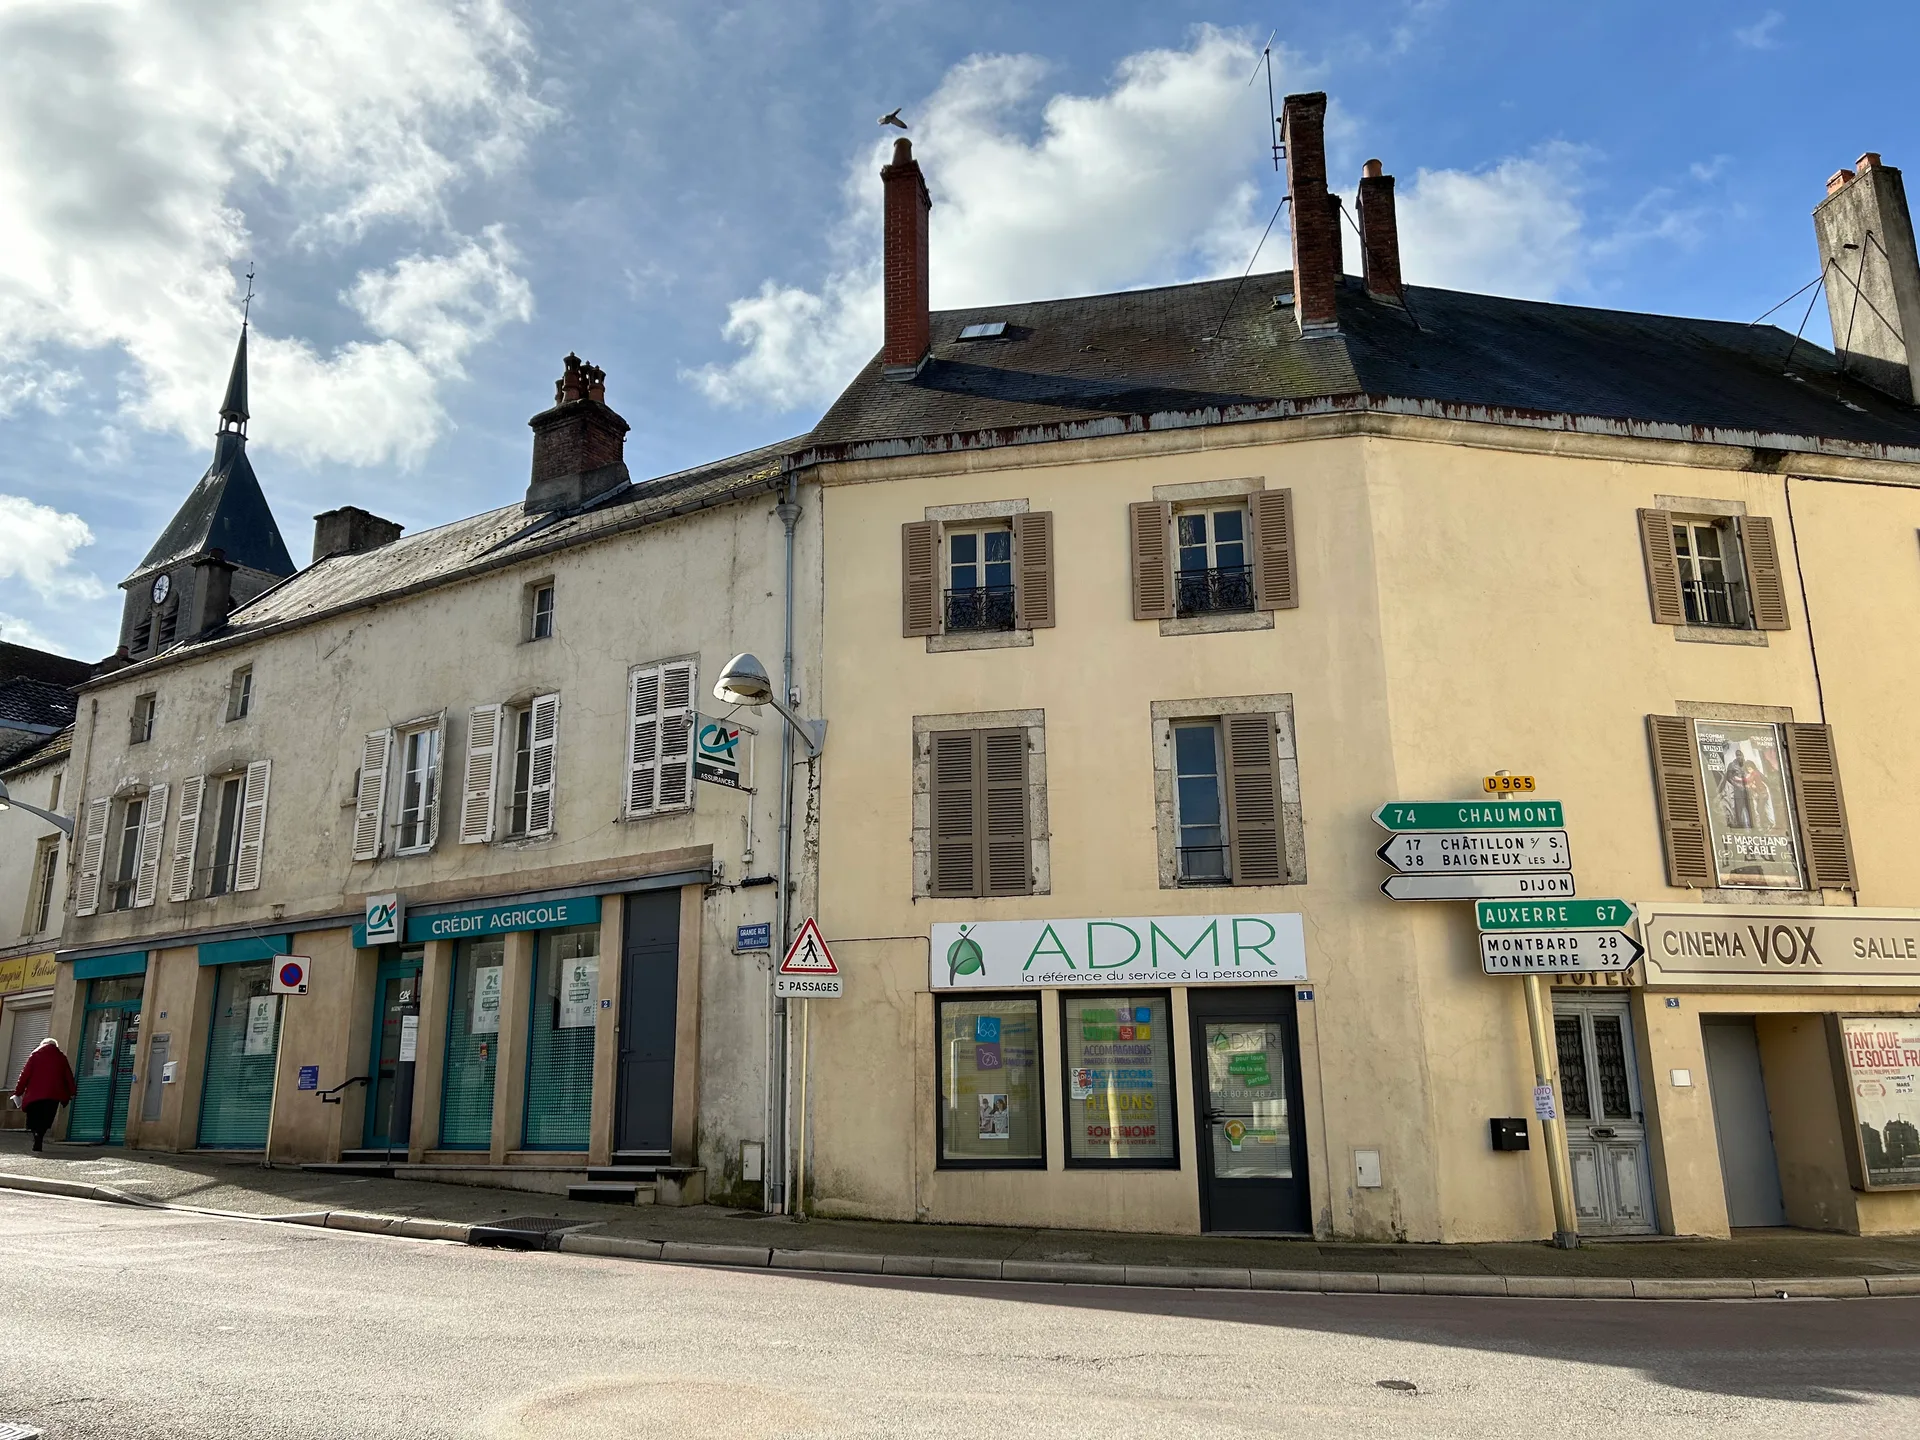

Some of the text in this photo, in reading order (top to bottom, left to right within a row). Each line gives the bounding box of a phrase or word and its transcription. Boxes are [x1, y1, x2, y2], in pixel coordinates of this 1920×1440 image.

[701, 772, 735, 787] ASSURANCES
[1488, 778, 1532, 789] D 965
[1394, 807, 1556, 824] 74 CHAUMONT
[1405, 839, 1421, 850] 17
[1440, 836, 1524, 850] CHÂTILLON
[1549, 837, 1563, 848] S.
[1722, 834, 1788, 846] LE MARCHAND
[1737, 845, 1777, 856] DE SABLE
[1405, 853, 1565, 866] 38 BAIGNEUX LES J.
[1520, 879, 1569, 891] DIJON
[431, 906, 568, 934] CRÉDIT AGRICOLE
[1485, 906, 1617, 923] AUXERRE 67
[740, 927, 766, 937] GRANDE RUE
[1022, 917, 1277, 971] ADMR
[1487, 937, 1617, 951] MONTBARD 28
[1662, 924, 1918, 966] CINEMA VOX SALLE
[1490, 953, 1620, 967] TONNERRE 32
[574, 966, 587, 982] 6€
[1022, 969, 1278, 982] la référence du service à la personne
[778, 981, 839, 992] 5 PASSAGES
[1303, 991, 1308, 1000] 1
[603, 1000, 609, 1008] 2
[1669, 998, 1676, 1007] 3
[257, 1003, 268, 1016] 6€
[1845, 1032, 1901, 1051] TANT QUE
[1084, 1045, 1152, 1055] ACCOMPAGNONS
[1849, 1050, 1865, 1067] LE
[1865, 1050, 1903, 1067] SOLEIL
[1247, 1074, 1270, 1085] partout
[1534, 1087, 1551, 1095] LOTO
